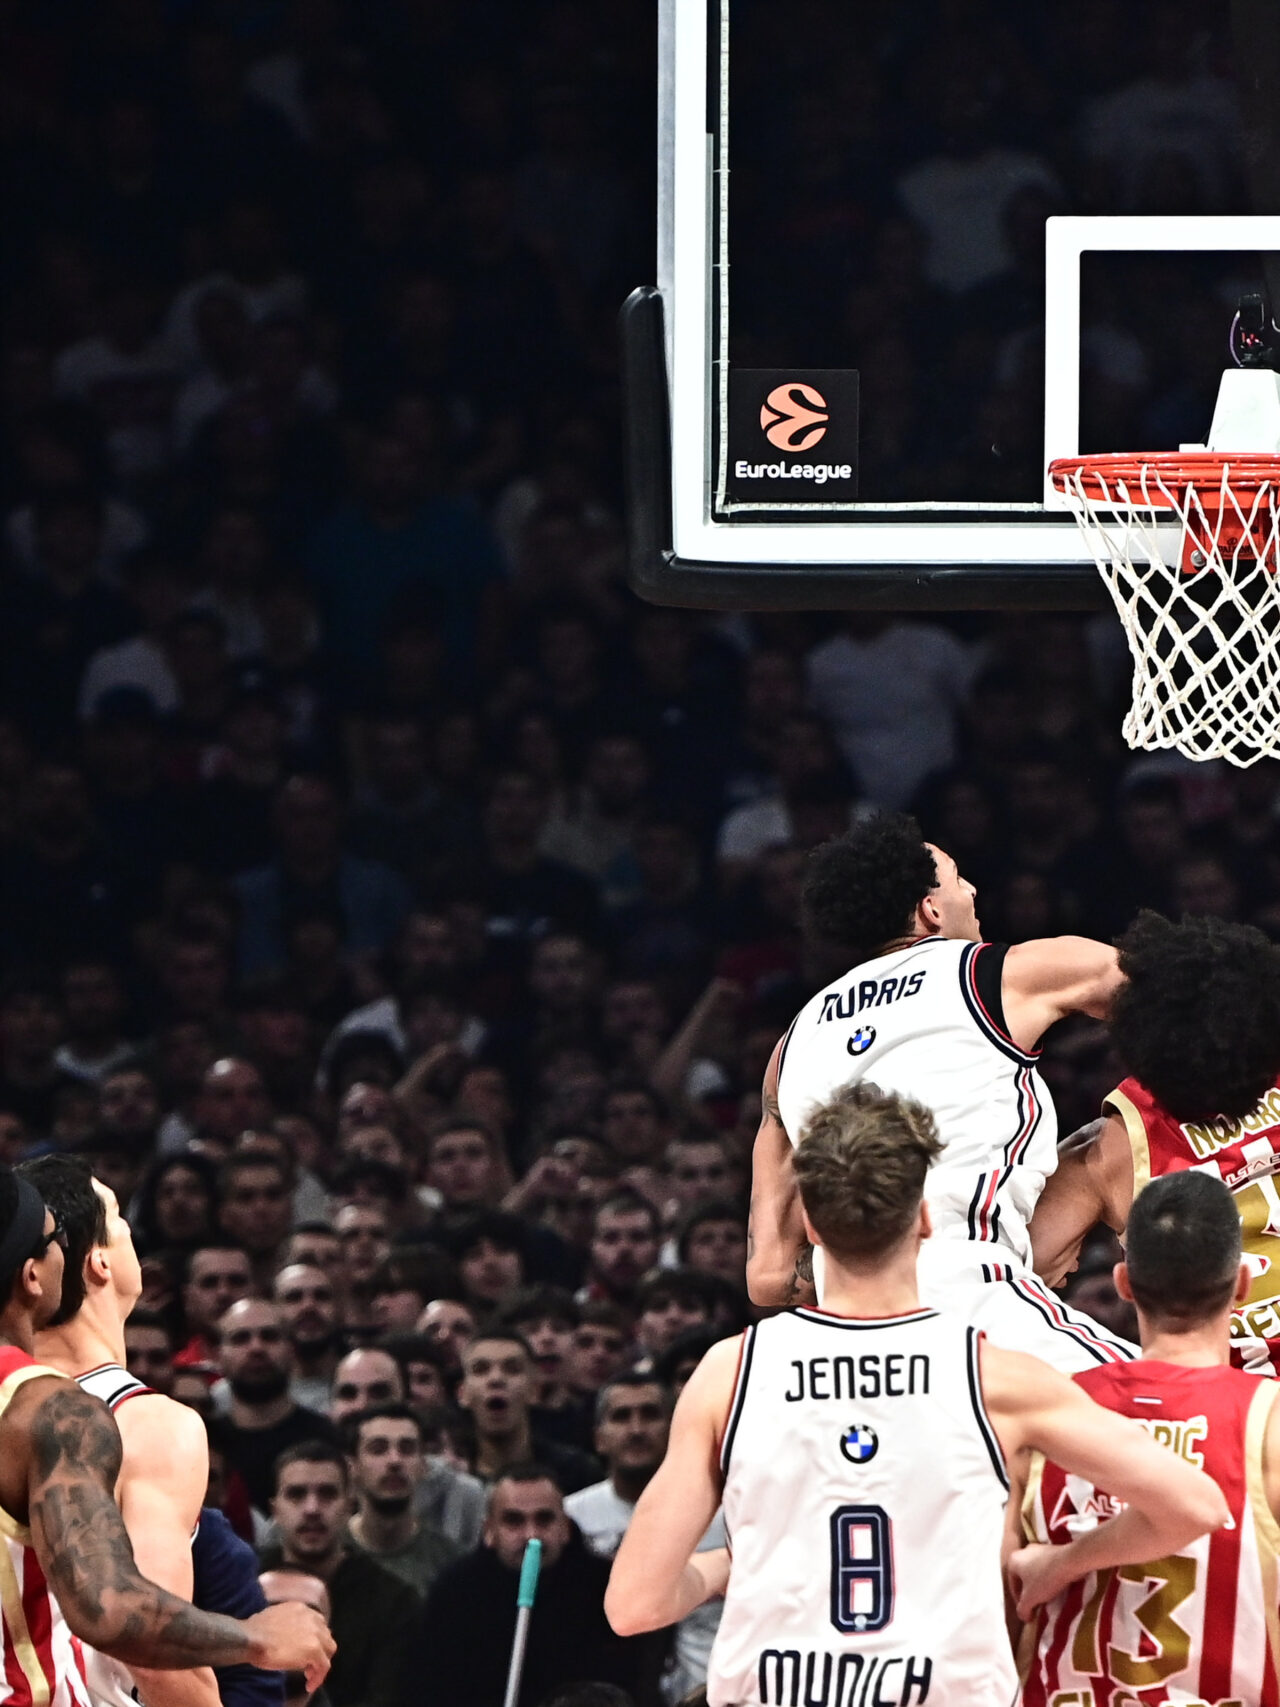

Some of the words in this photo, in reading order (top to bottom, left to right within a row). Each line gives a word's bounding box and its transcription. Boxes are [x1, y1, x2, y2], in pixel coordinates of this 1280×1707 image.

[735, 460, 852, 485] EuroLeague
[1224, 1160, 1266, 1186] LTA
[785, 1354, 930, 1402] JENSEN
[829, 1504, 896, 1636] 8
[1072, 1554, 1198, 1686] 13
[758, 1649, 933, 1707] MUNICH
